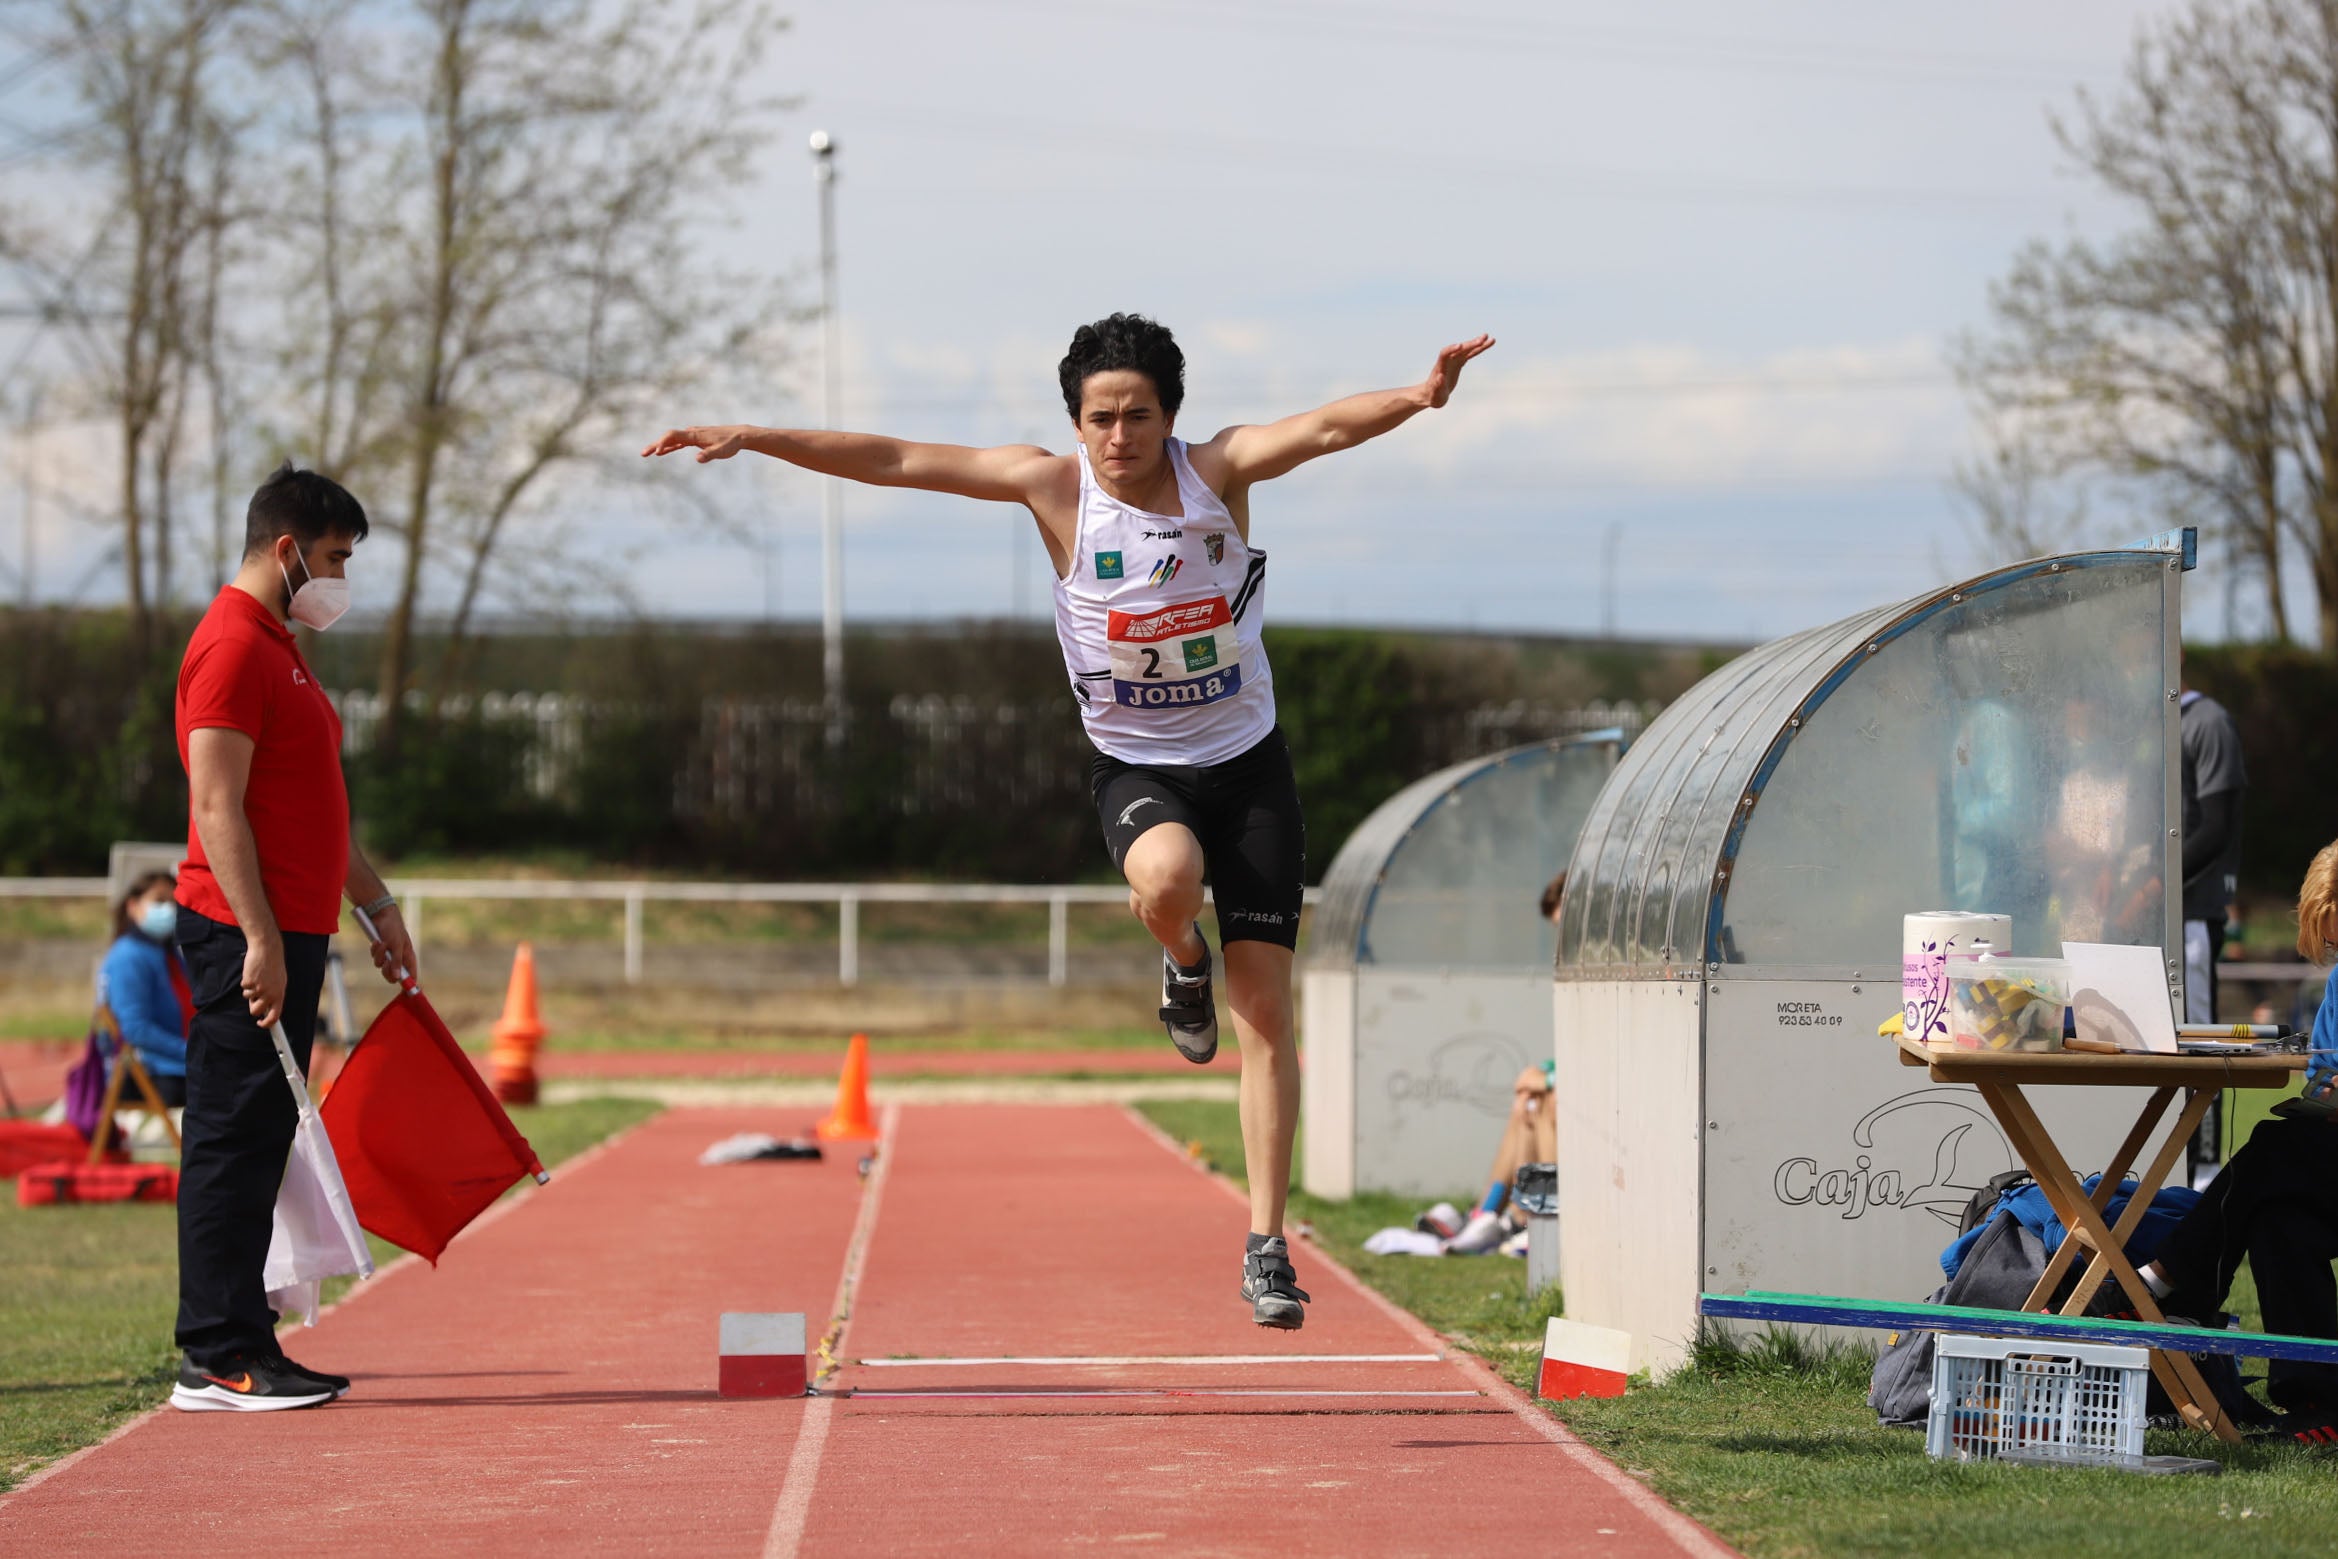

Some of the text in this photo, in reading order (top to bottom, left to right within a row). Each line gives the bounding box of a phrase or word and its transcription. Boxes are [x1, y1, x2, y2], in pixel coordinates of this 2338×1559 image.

[1158, 603, 1215, 627] RFEA
[1156, 618, 1211, 636] ATLETISMO
[1140, 647, 1163, 679] 2
[1777, 1002, 1822, 1013] MORETA
[1778, 1015, 1797, 1026] 923
[1829, 1016, 1843, 1026] 09
[1774, 1154, 1905, 1220] Caja
